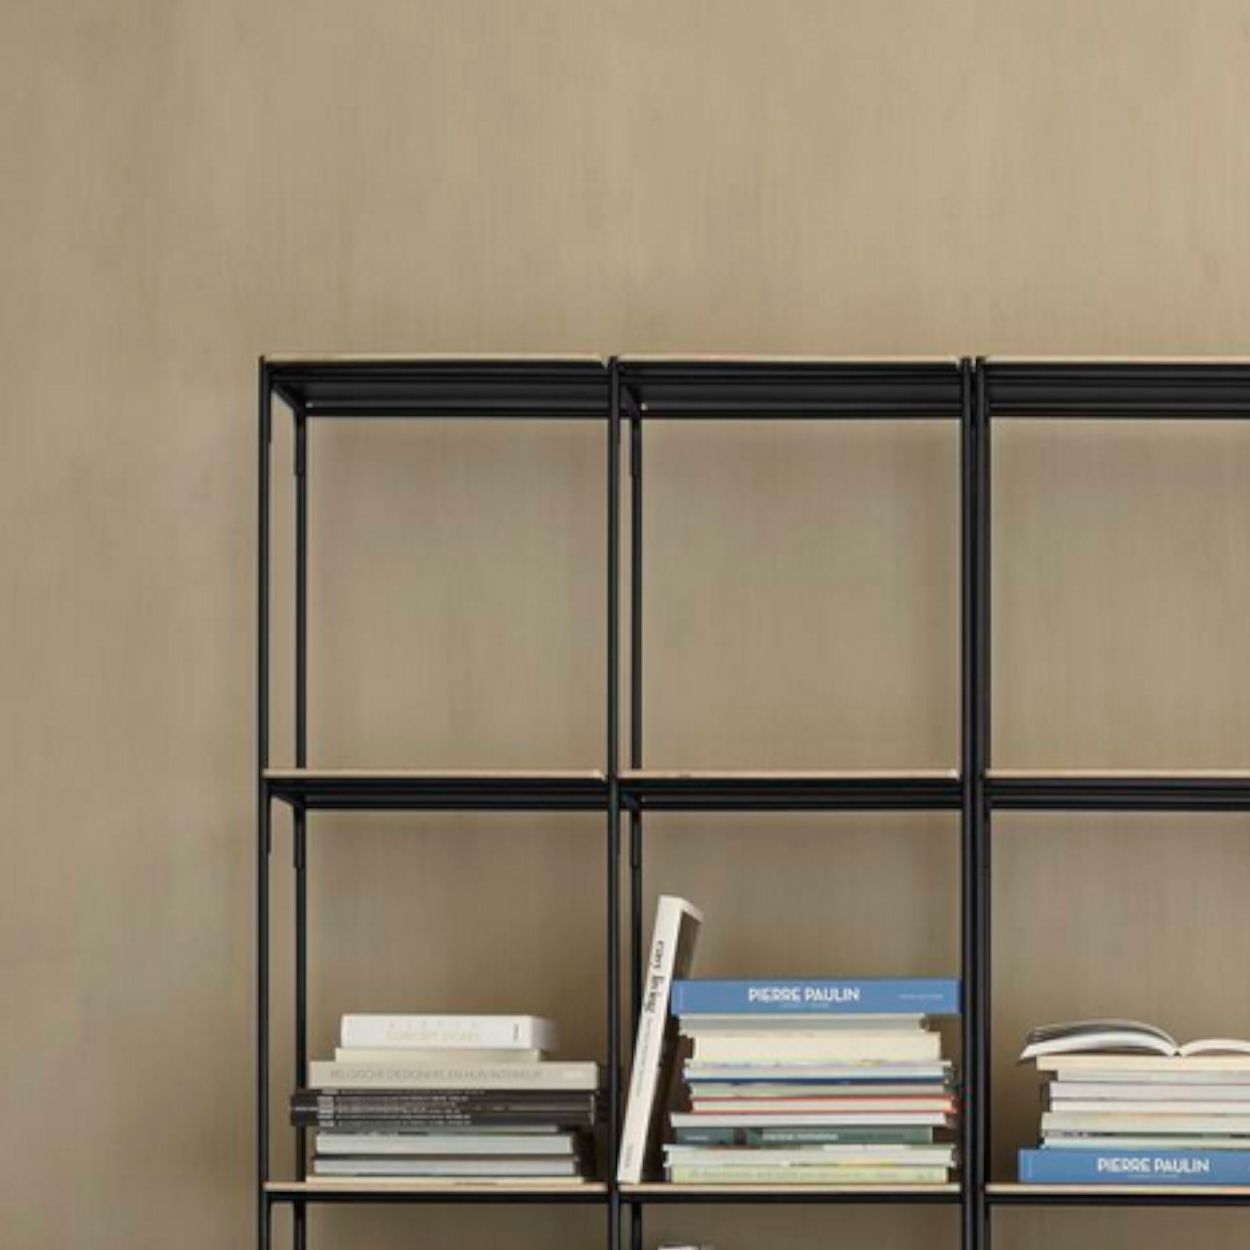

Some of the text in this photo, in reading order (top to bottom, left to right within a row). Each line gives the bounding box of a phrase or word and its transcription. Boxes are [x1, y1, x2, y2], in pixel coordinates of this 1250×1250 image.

[748, 987, 860, 1002] PIERRE PAULIN
[1097, 1157, 1210, 1173] PIERRE PAULIN
